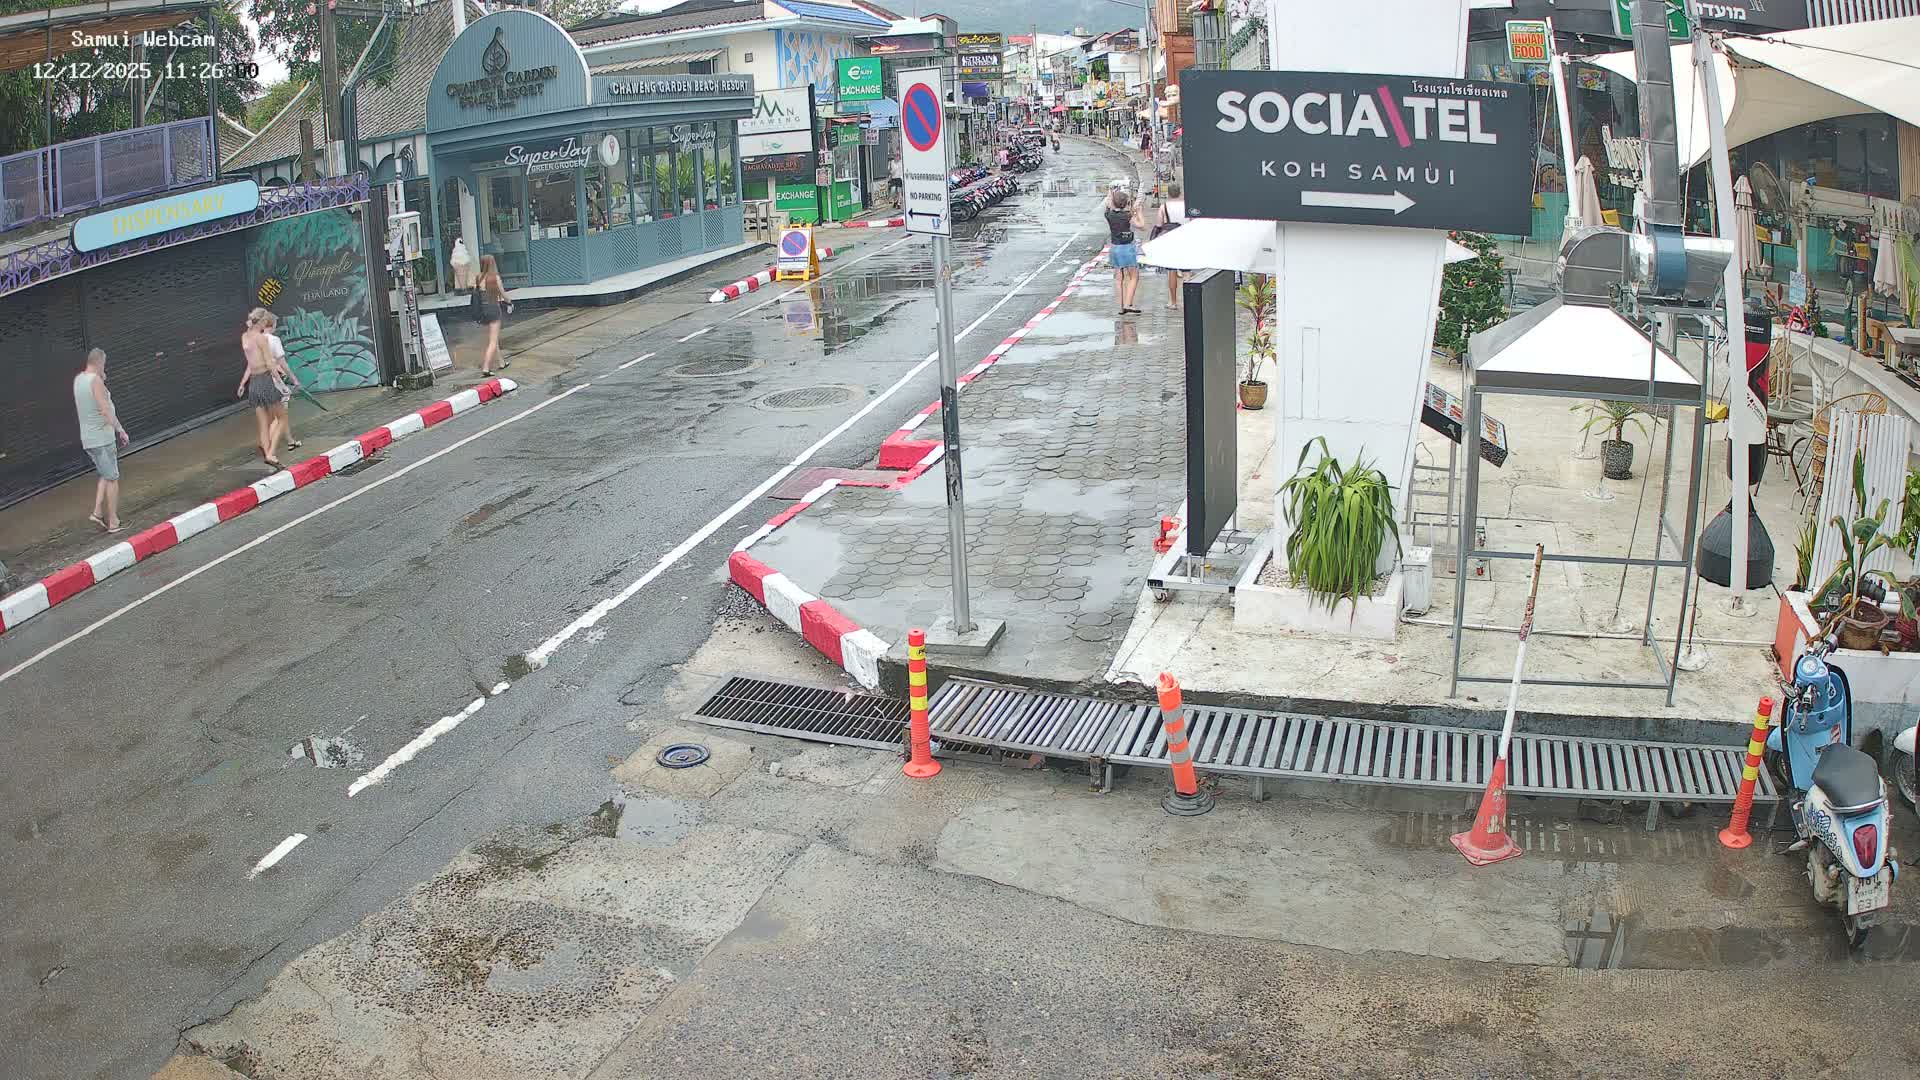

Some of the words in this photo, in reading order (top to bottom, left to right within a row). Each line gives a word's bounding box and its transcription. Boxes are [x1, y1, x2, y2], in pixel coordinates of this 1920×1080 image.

[1511, 32, 1544, 45] INDIAN
[1514, 45, 1544, 58] FOOD
[505, 65, 557, 84] GARDEN
[611, 81, 656, 95] CHAWENG
[658, 80, 692, 93] GARDEN
[694, 79, 719, 92] BEACH
[721, 78, 749, 91] RESORT
[840, 84, 881, 96] EXCHANGE
[742, 116, 801, 128] CHAWENG
[531, 162, 554, 172] GREEN
[554, 159, 586, 170] GROCER
[1261, 159, 1327, 179] KOH
[1347, 161, 1455, 186] SAMUI
[776, 190, 815, 201] EXCHANGE
[910, 191, 917, 200] NO
[918, 192, 942, 201] PARKING
[112, 191, 226, 236] DISPENSARY
[302, 286, 349, 302] THAILAND
